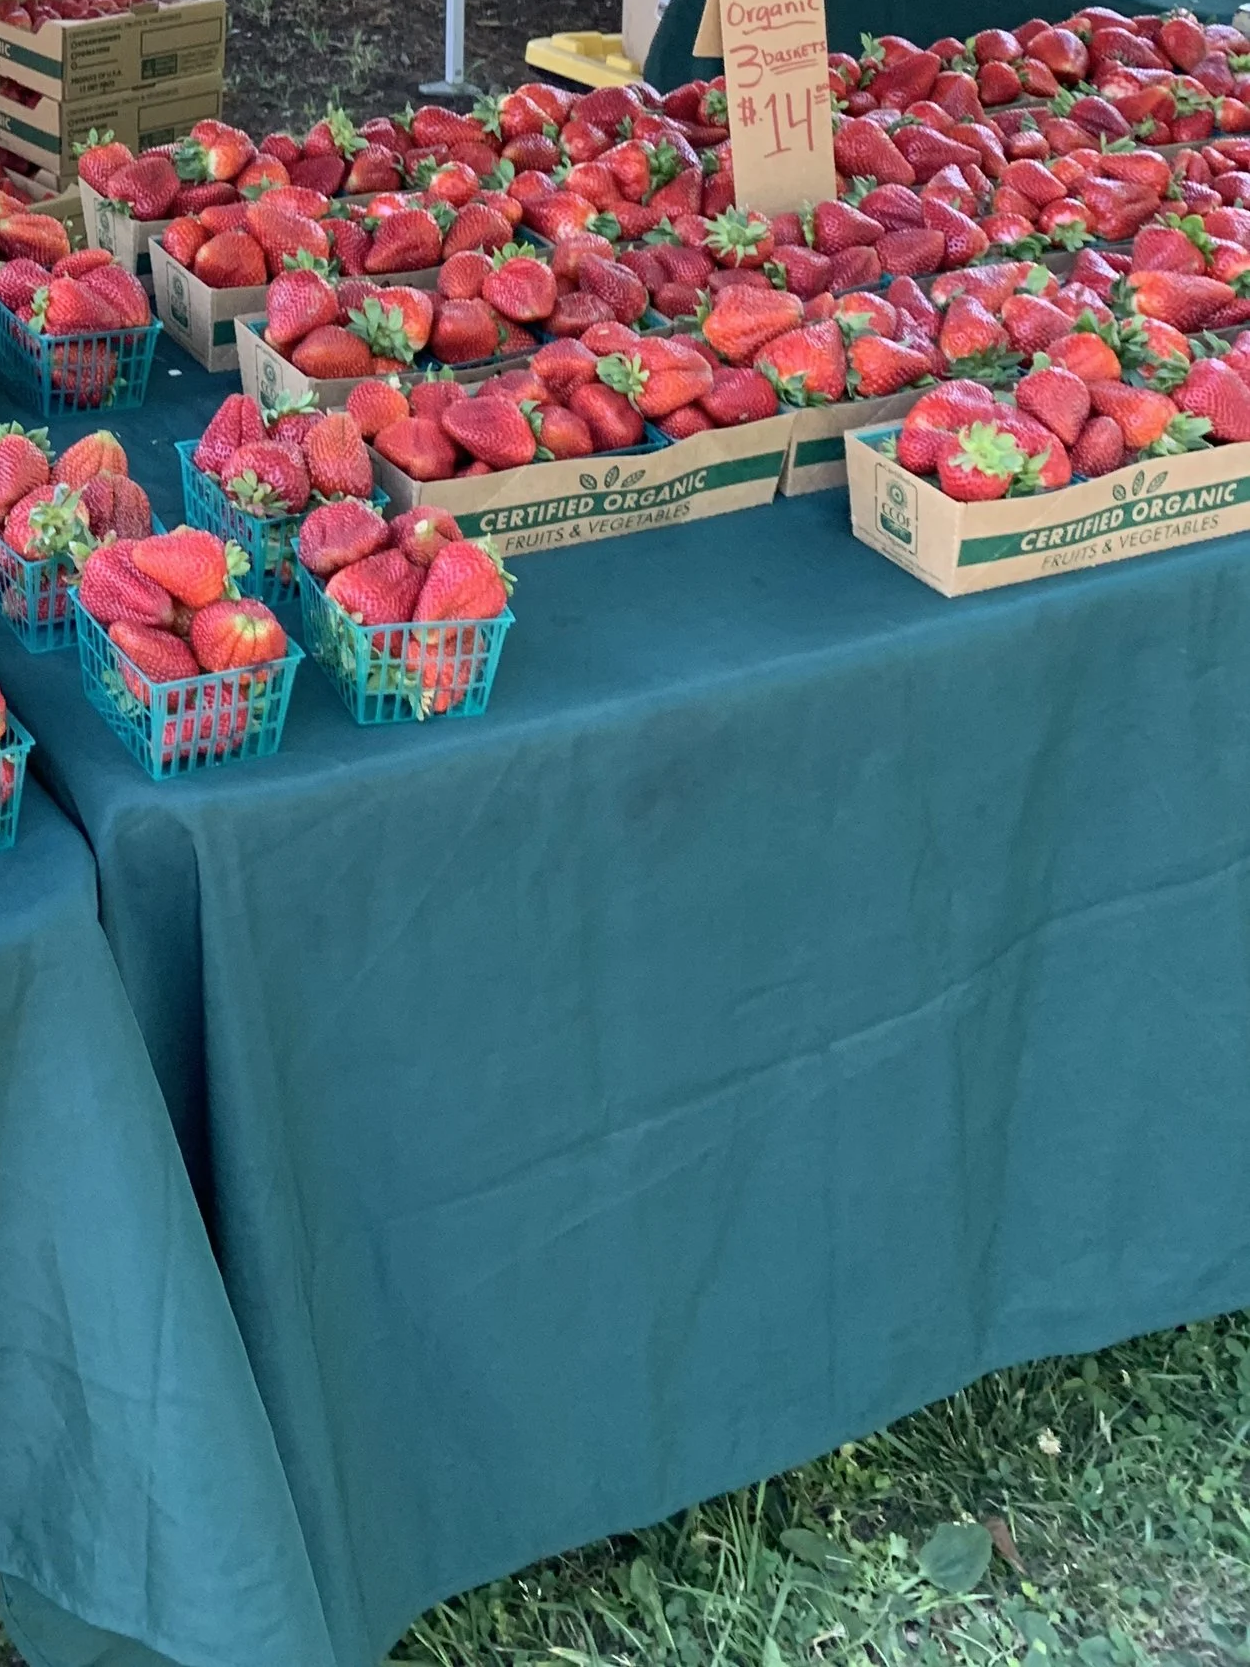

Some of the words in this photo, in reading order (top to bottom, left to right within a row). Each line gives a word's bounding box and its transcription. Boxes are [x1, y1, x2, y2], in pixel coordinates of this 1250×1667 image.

[730, 44, 763, 88] 3
[479, 497, 594, 532] CERTIFIED
[603, 470, 708, 512] ORGANIC
[504, 528, 564, 551] FRUITS
[569, 524, 582, 537] &
[588, 501, 691, 534] VEGETABLES
[1020, 508, 1125, 552] CERTIFIED
[1131, 483, 1238, 522] ORGANIC
[1041, 543, 1098, 570] FRUITS
[1102, 539, 1112, 554] &
[1119, 514, 1220, 549] VEGETABLES
